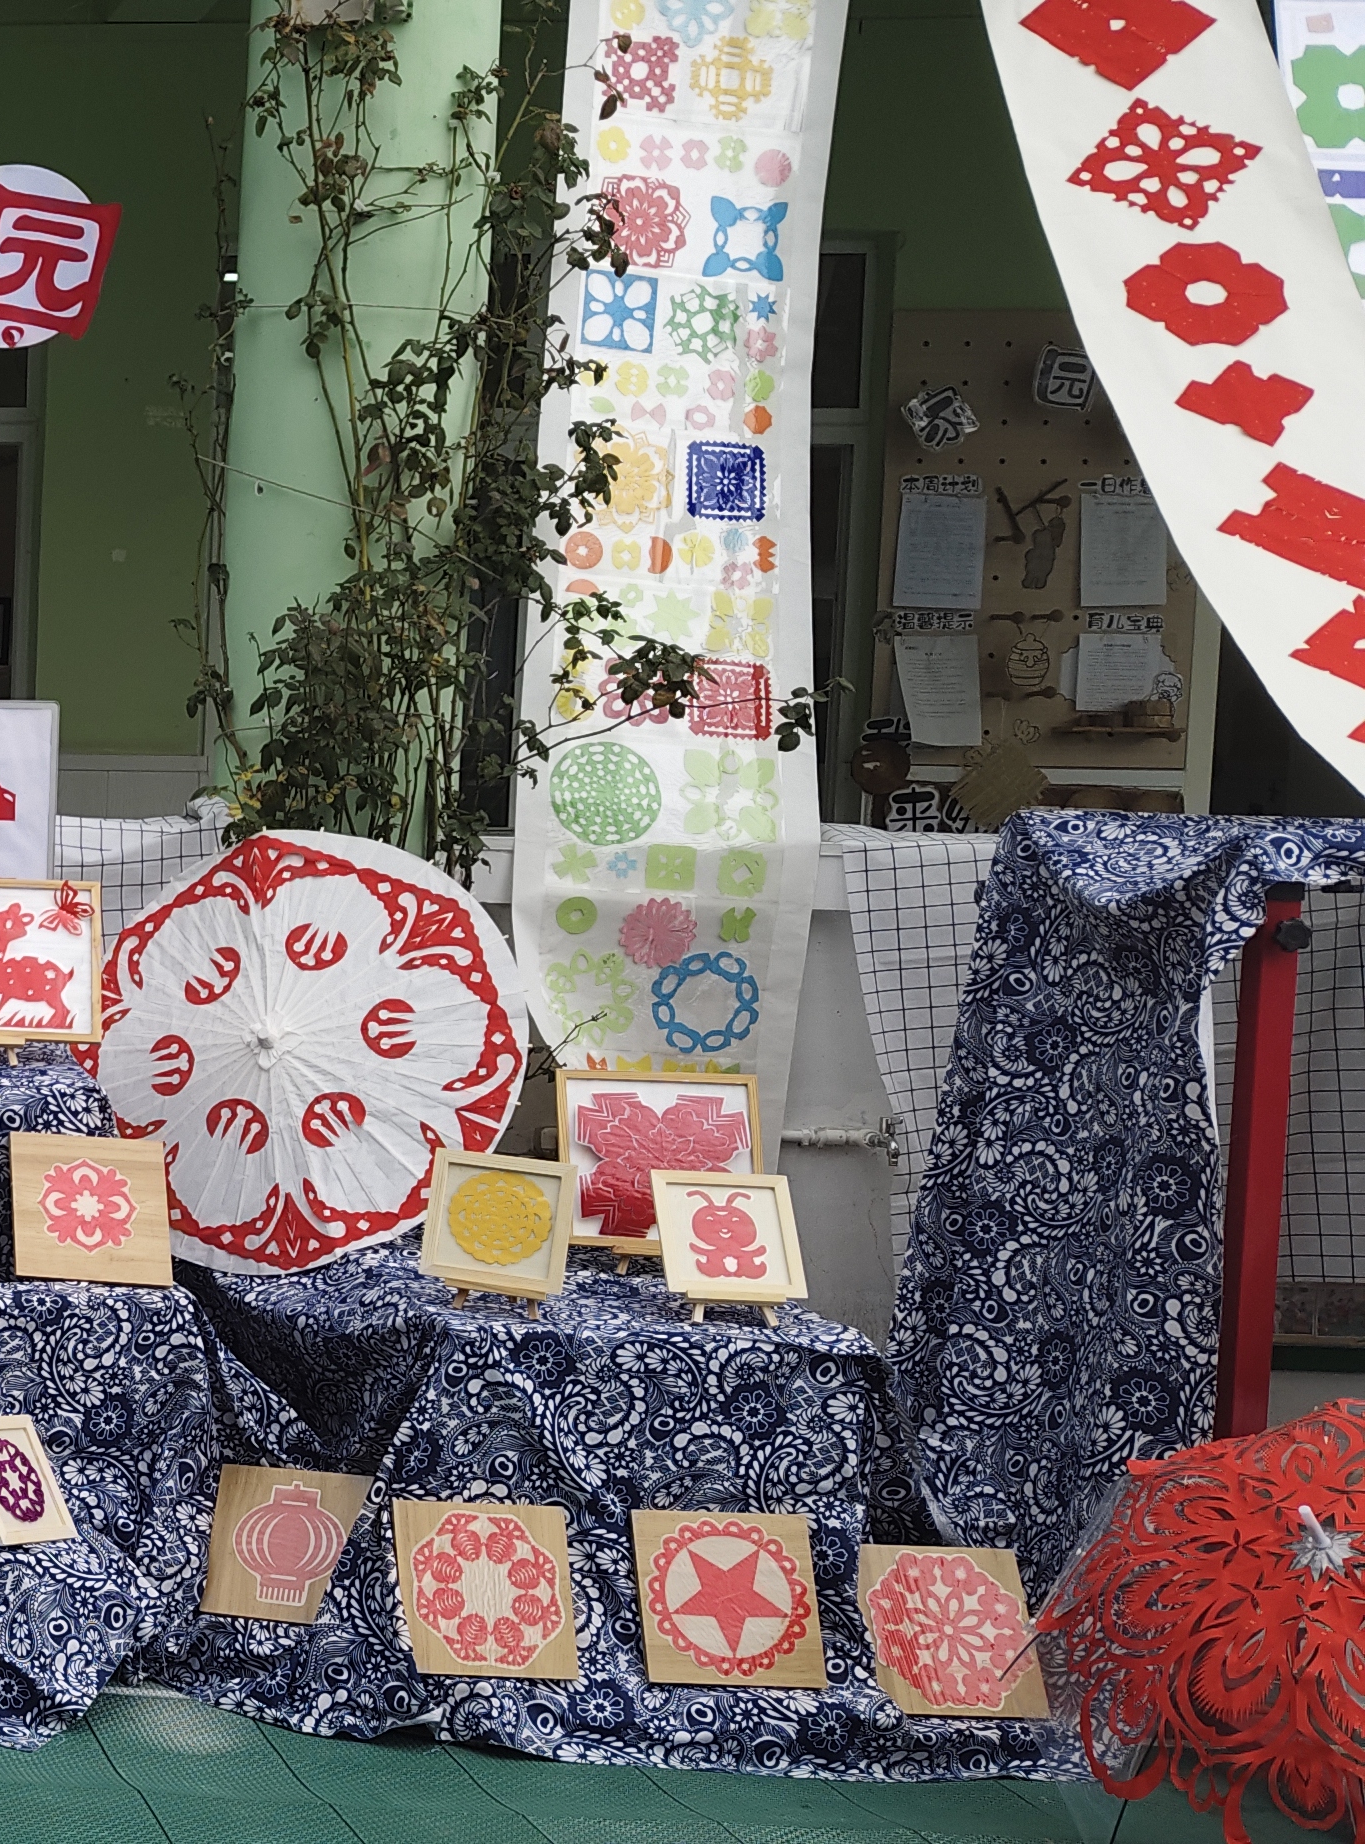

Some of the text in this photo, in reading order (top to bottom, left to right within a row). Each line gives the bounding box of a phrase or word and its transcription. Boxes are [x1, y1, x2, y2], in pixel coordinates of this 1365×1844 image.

[901, 475, 979, 493] 本周计划
[896, 612, 974, 630] 温馨提示
[1087, 612, 1164, 633] 育儿宝典
